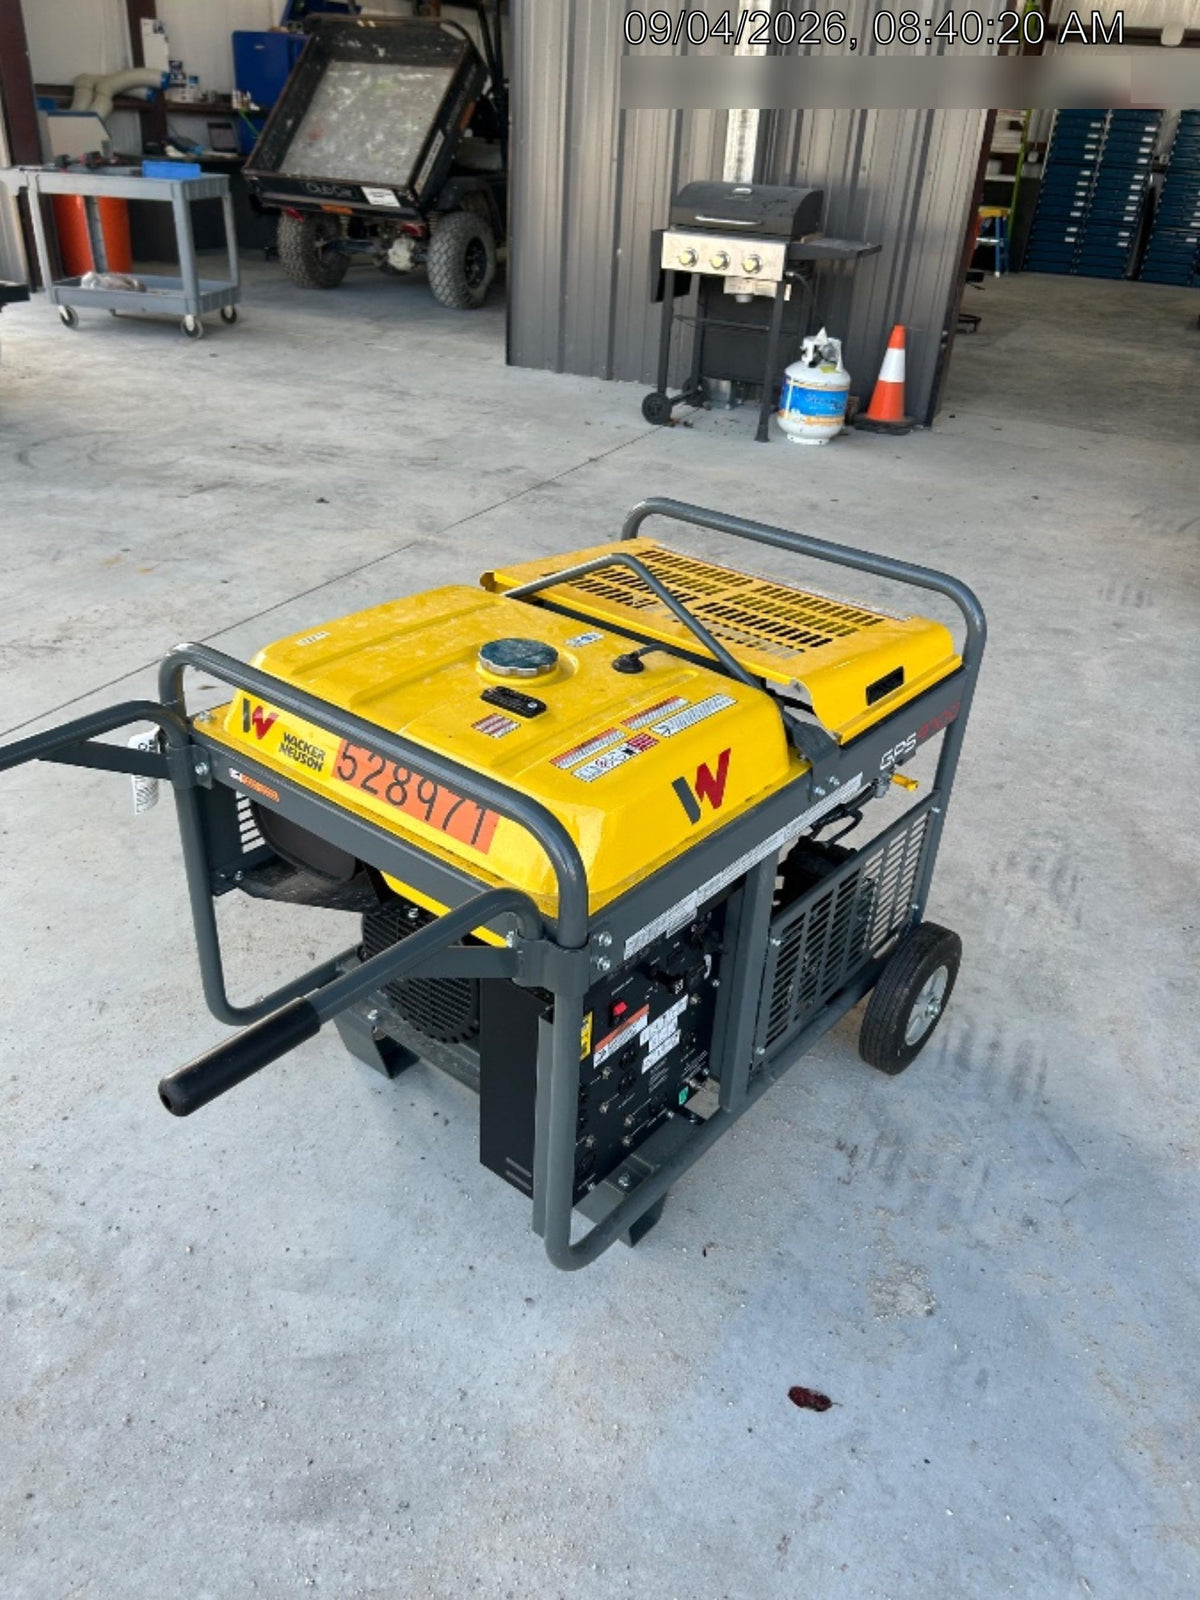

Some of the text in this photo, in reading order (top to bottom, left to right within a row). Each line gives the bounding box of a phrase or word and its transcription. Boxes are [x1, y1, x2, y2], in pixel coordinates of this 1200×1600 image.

[279, 742, 324, 772] NEUSON
[283, 731, 326, 761] WACKER
[880, 732, 917, 770] GPS
